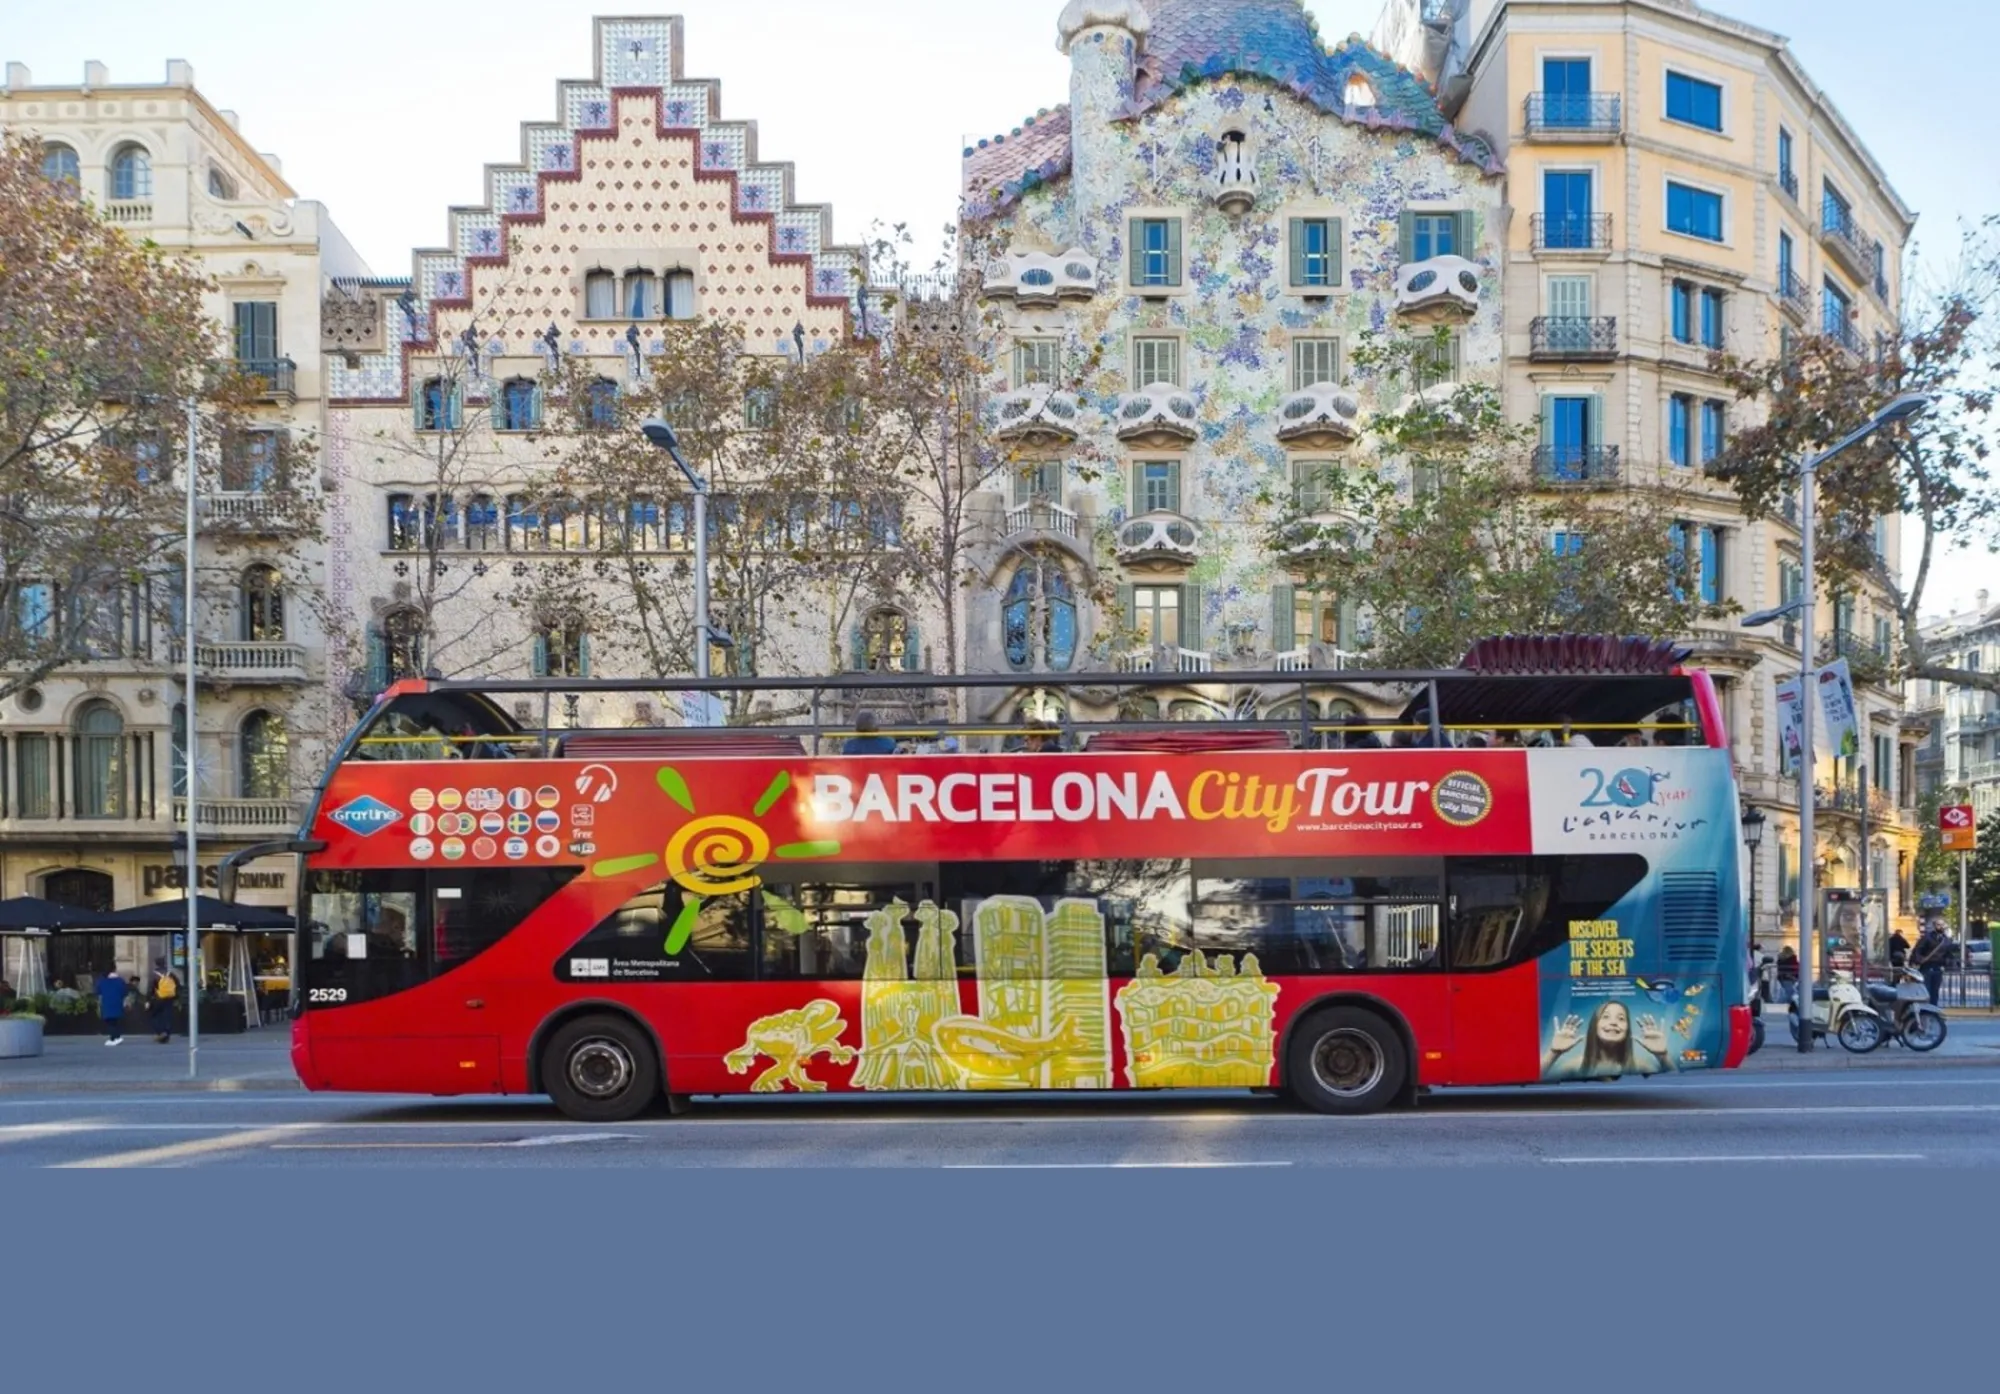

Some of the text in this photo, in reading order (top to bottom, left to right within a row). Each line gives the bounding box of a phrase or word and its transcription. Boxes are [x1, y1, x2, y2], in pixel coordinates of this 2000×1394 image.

[812, 767, 1430, 833] BARCELONA City Tour
[1297, 821, 1423, 833] www.barcelonacitytour.es
[1589, 831, 1680, 841] BARCELONA
[238, 872, 286, 889] COMPANY
[1569, 920, 1618, 938] DISCOVER
[1570, 939, 1635, 958] THE SECRETS
[630, 959, 680, 969] Metropolitana
[1570, 959, 1626, 977] OF THE SEA
[624, 968, 660, 977] Barcelona
[309, 987, 348, 1002] 2529
